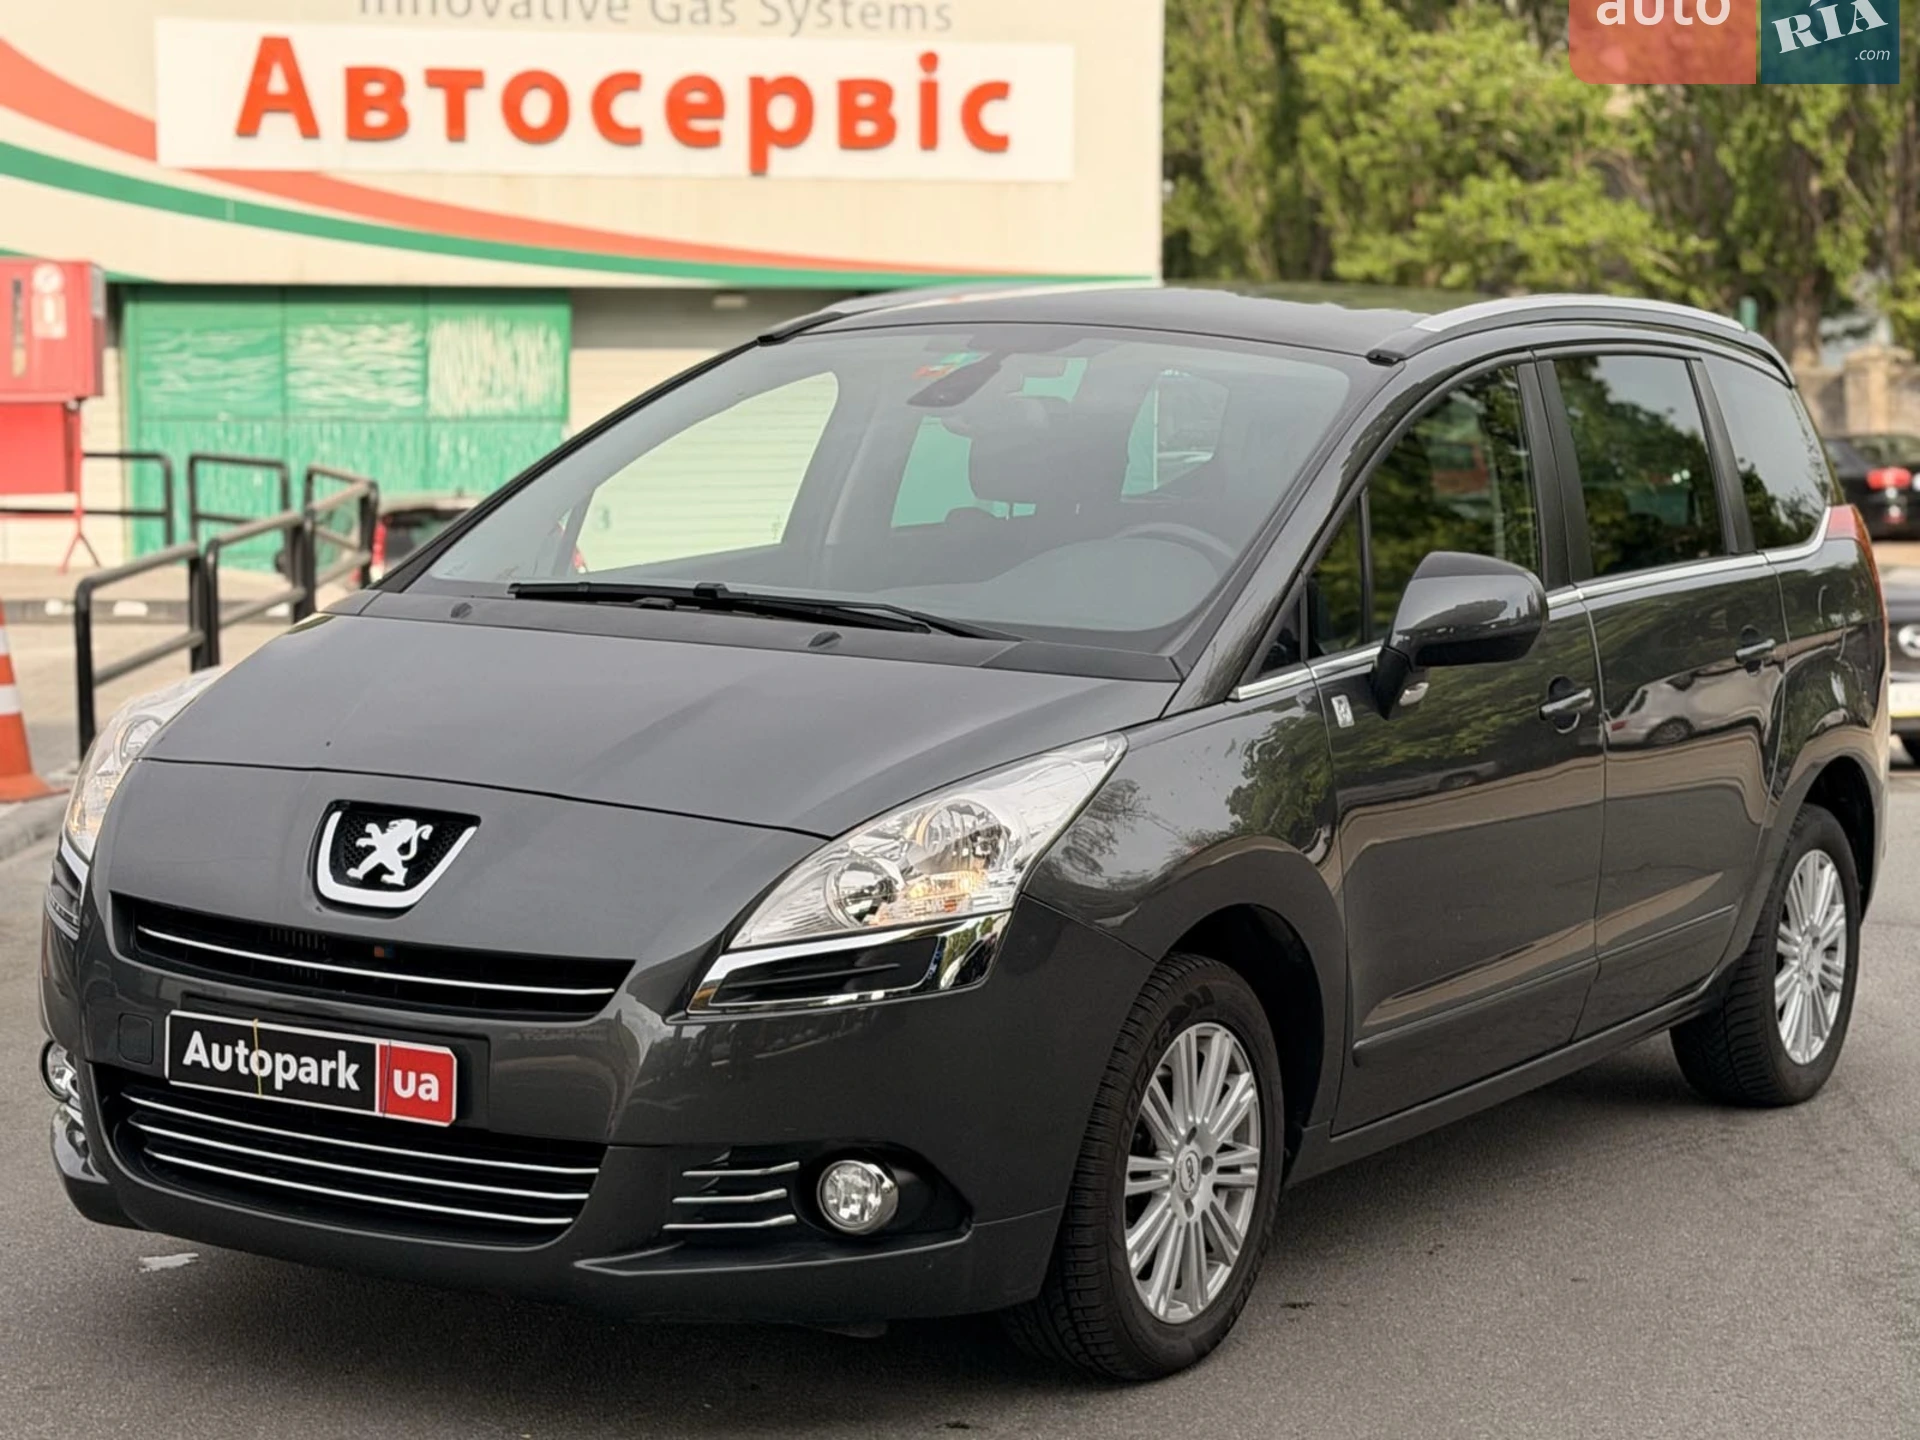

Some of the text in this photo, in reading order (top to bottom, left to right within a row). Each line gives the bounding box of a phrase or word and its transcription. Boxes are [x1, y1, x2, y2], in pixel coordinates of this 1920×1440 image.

[650, 0, 738, 26] Gas
[760, 0, 952, 37] Systems
[236, 36, 1011, 177] Автосервіс
[182, 1030, 440, 1103] Autopark ua
